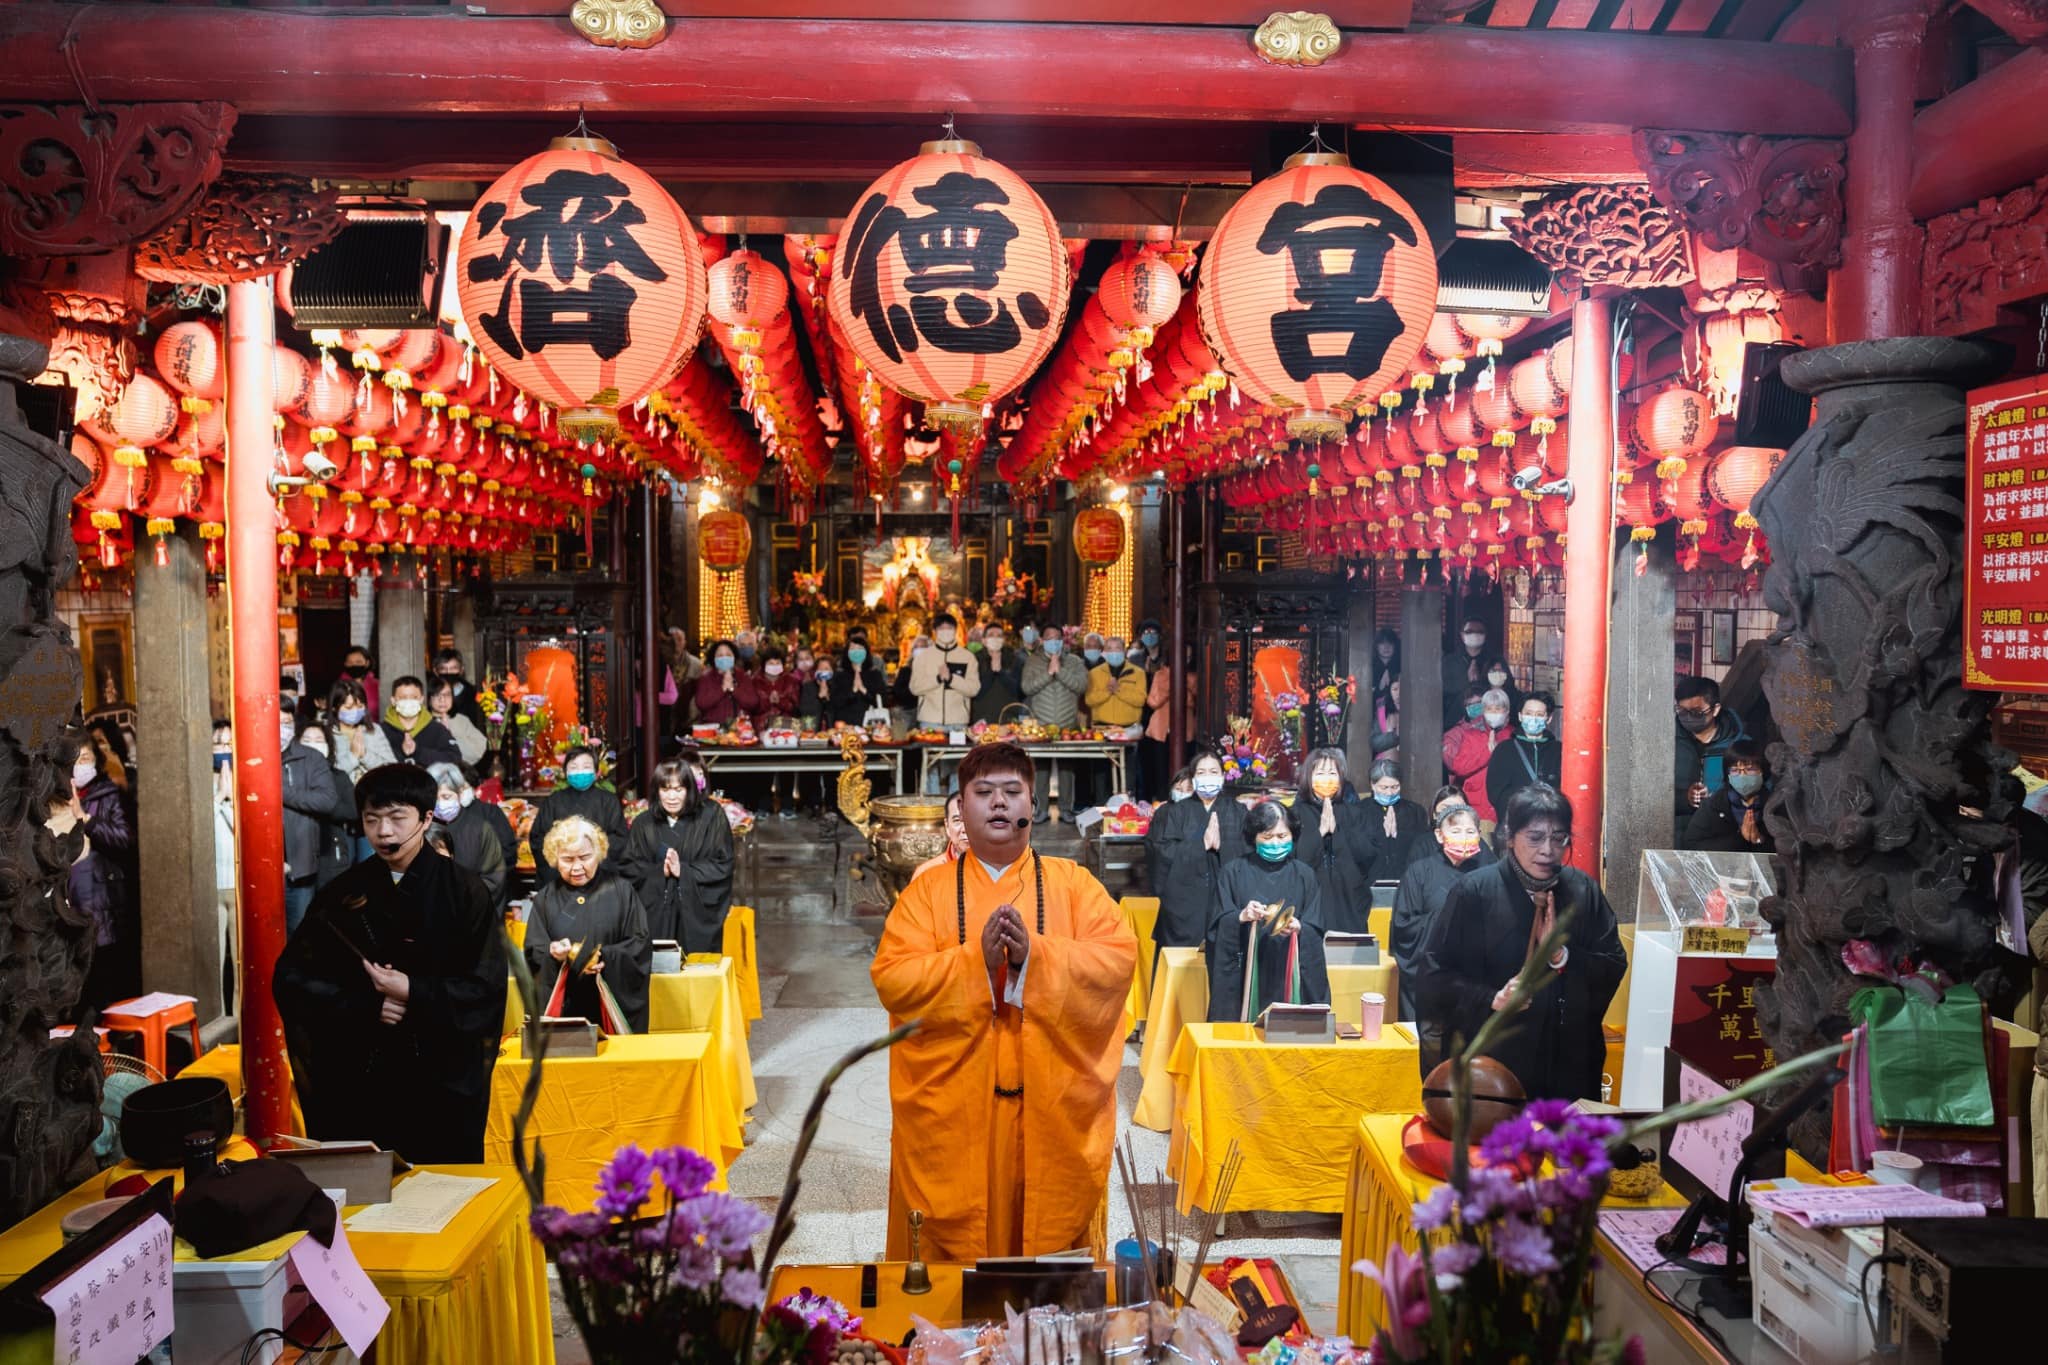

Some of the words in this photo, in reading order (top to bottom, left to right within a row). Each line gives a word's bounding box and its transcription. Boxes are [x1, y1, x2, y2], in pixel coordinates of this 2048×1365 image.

[842, 171, 1050, 363] 德
[1256, 184, 1418, 382] 宮
[1984, 424, 2048, 449] 該當年太歲
[1984, 440, 2048, 464] 太歲燈,以
[1984, 469, 2025, 489] 財神燈
[1982, 531, 2024, 549] 平安燈
[1981, 609, 2022, 625] 光明燈
